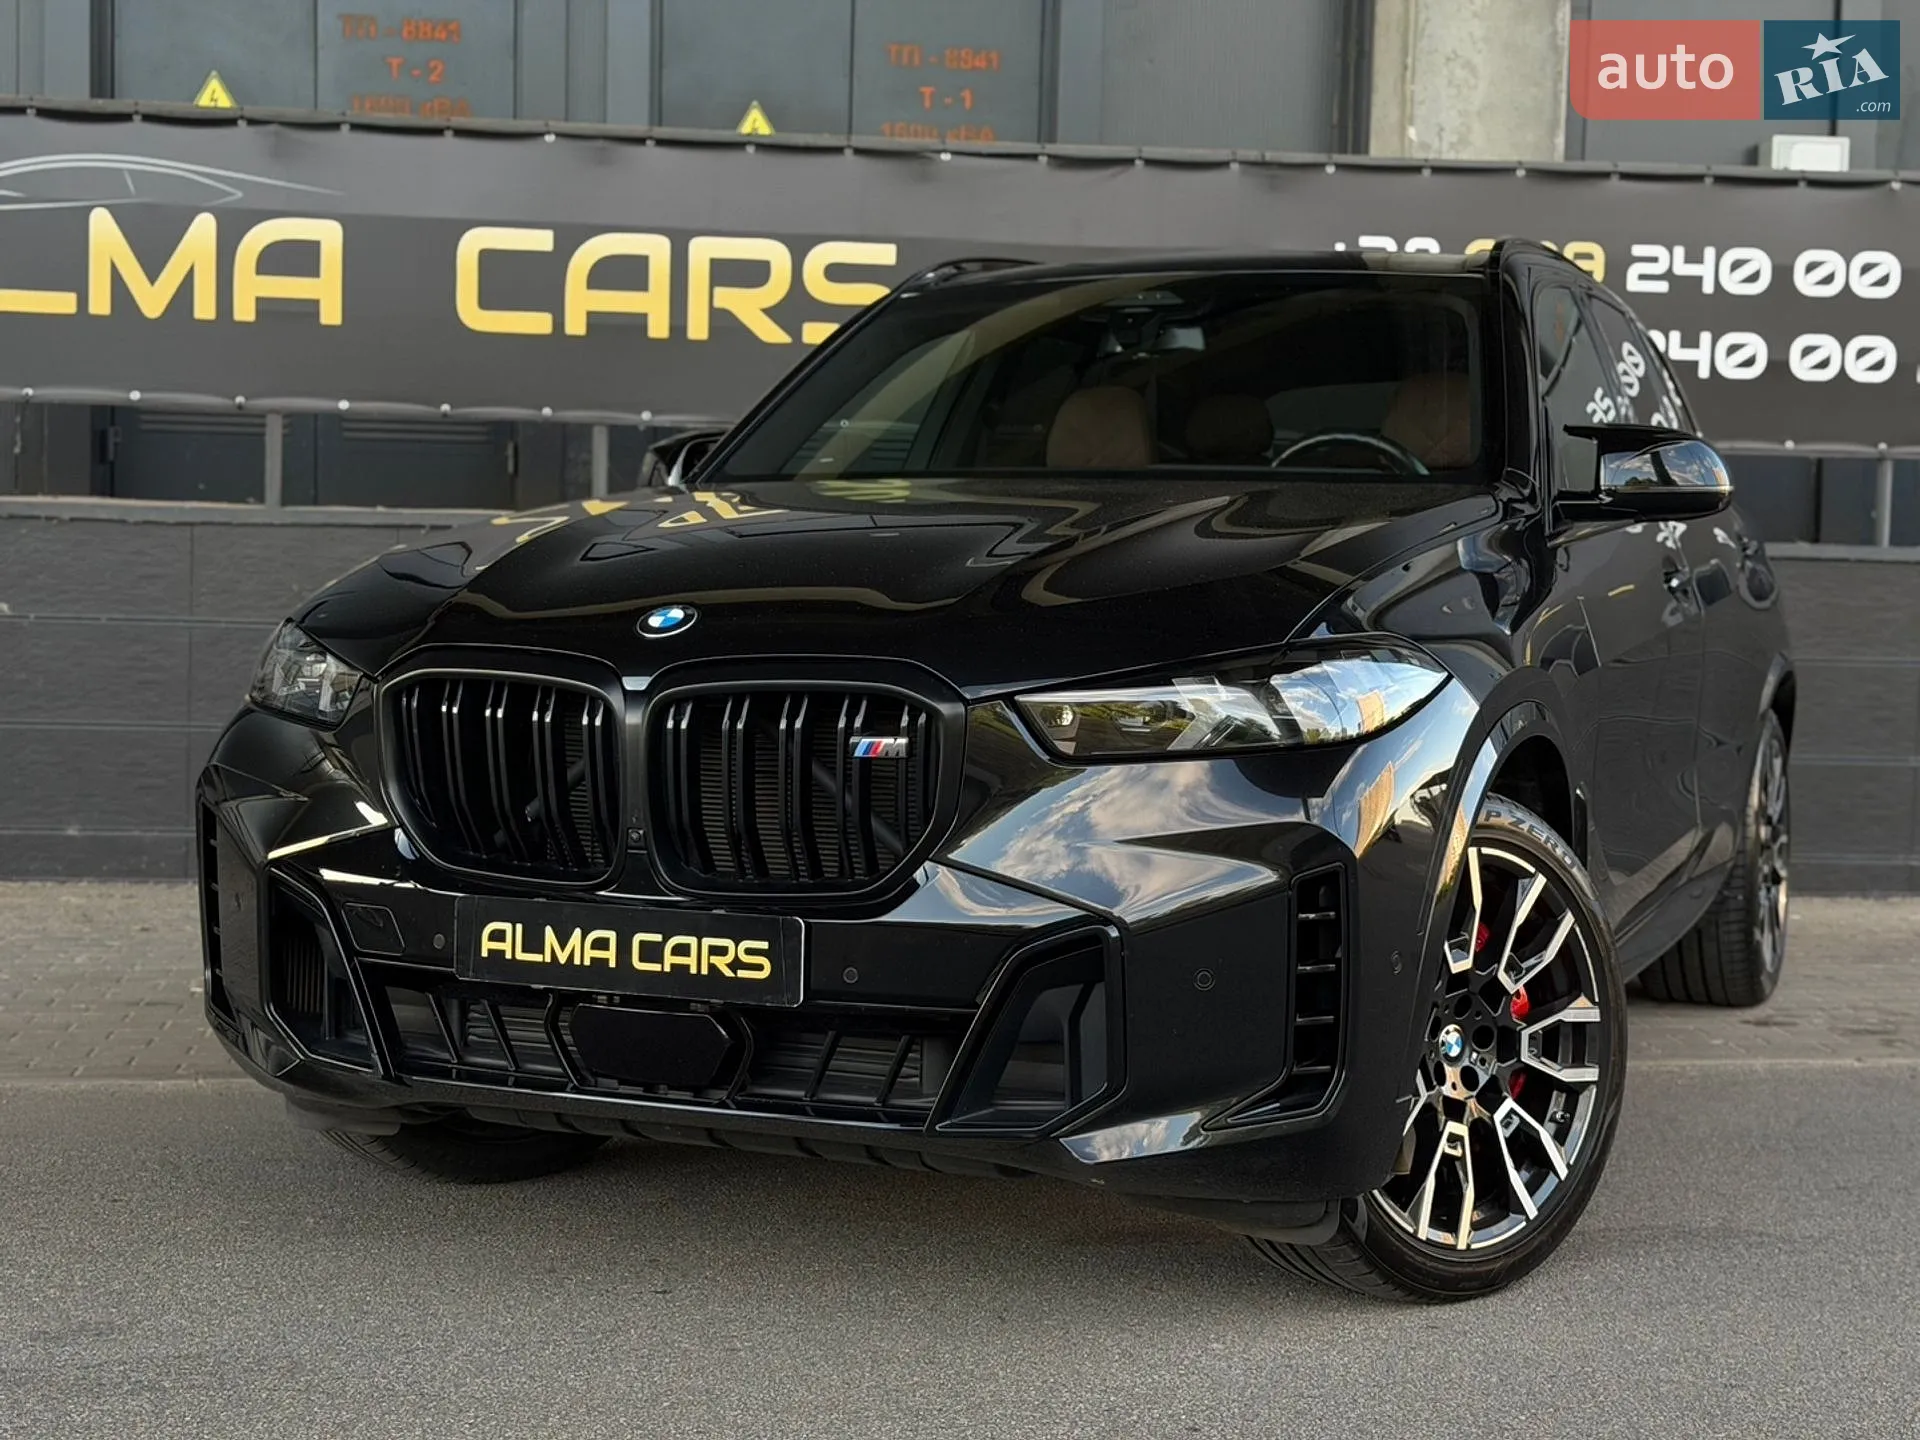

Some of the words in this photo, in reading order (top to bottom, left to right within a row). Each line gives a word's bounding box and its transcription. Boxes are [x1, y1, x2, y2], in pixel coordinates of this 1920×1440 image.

[427, 58, 446, 85] 2
[961, 87, 974, 112] 1
[455, 226, 898, 346] CARS
[1625, 244, 1773, 296] 240
[1792, 249, 1902, 300] 00
[1788, 333, 1899, 384] 00
[481, 921, 617, 968] ALMA
[631, 932, 772, 980] CARS
